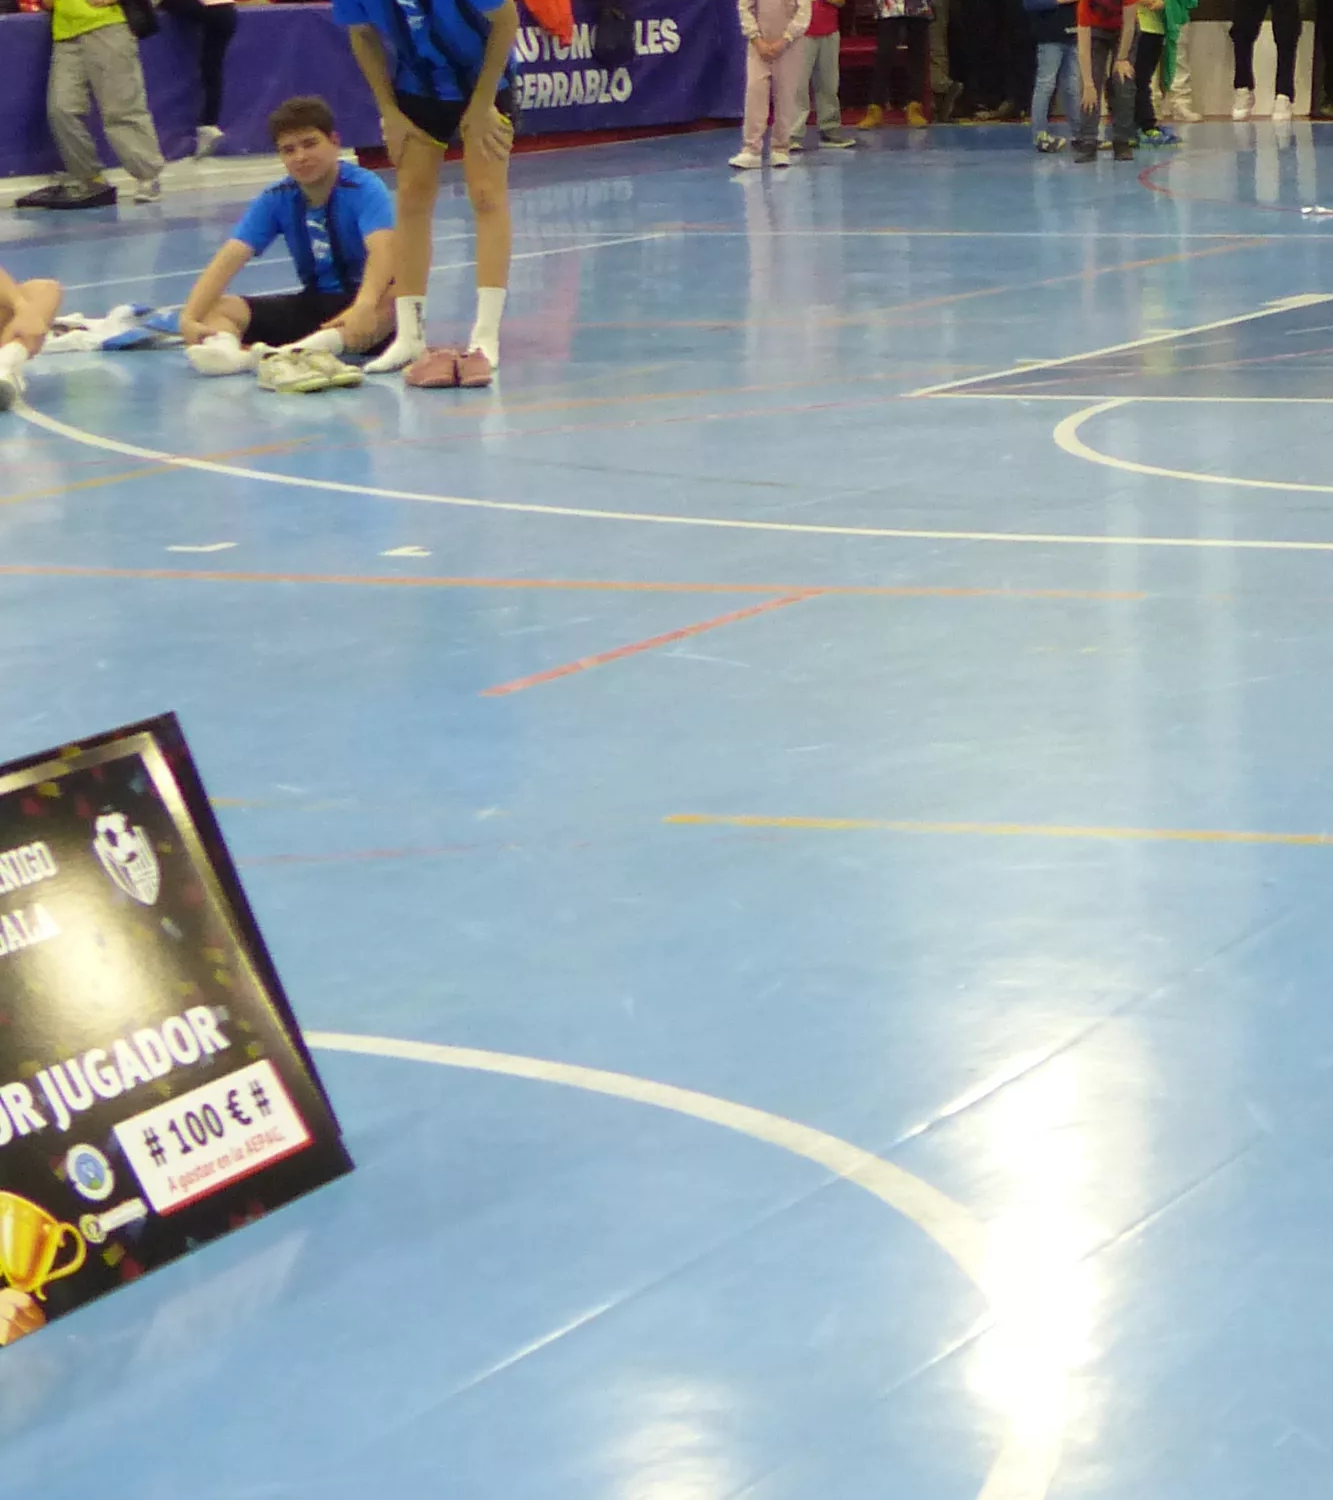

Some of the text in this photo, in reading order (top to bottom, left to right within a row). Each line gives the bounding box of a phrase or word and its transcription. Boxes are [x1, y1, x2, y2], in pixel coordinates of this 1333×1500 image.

[0, 841, 58, 893] NIGO
[0, 903, 61, 955] ALA
[36, 1006, 231, 1132] JUGADOR
[168, 1103, 224, 1155] 100
[227, 1089, 252, 1125] €
